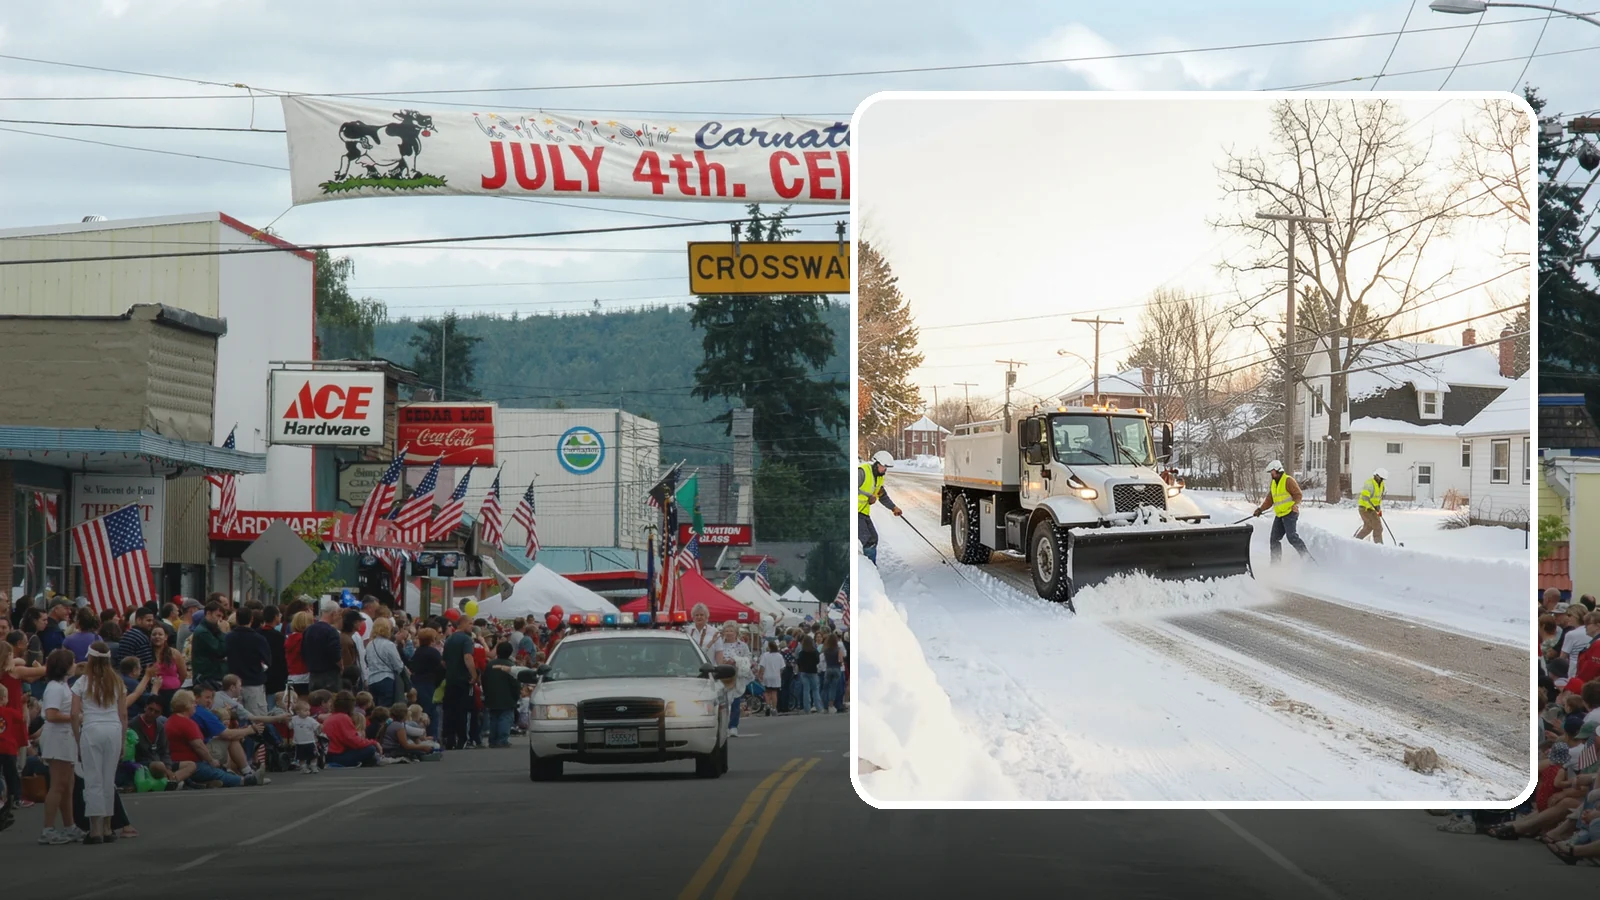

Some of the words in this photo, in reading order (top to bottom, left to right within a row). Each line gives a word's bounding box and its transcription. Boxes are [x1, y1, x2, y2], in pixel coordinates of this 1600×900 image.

[481, 140, 604, 192] JULY
[632, 150, 746, 198] 4th.
[697, 254, 850, 280] CROSSWA
[282, 379, 374, 420] ACE
[405, 409, 452, 421] CEDAR
[461, 409, 485, 421] LOG
[283, 421, 371, 436] Hardware
[416, 428, 477, 447] Coca-Cola
[354, 467, 384, 480] Simpl
[83, 486, 93, 494] St.
[95, 486, 124, 495] Vincent
[126, 486, 136, 495] de
[137, 486, 155, 496] Paul
[212, 515, 330, 535] HARDARE
[688, 526, 742, 535] CRNATION
[699, 535, 730, 544] GLASS
